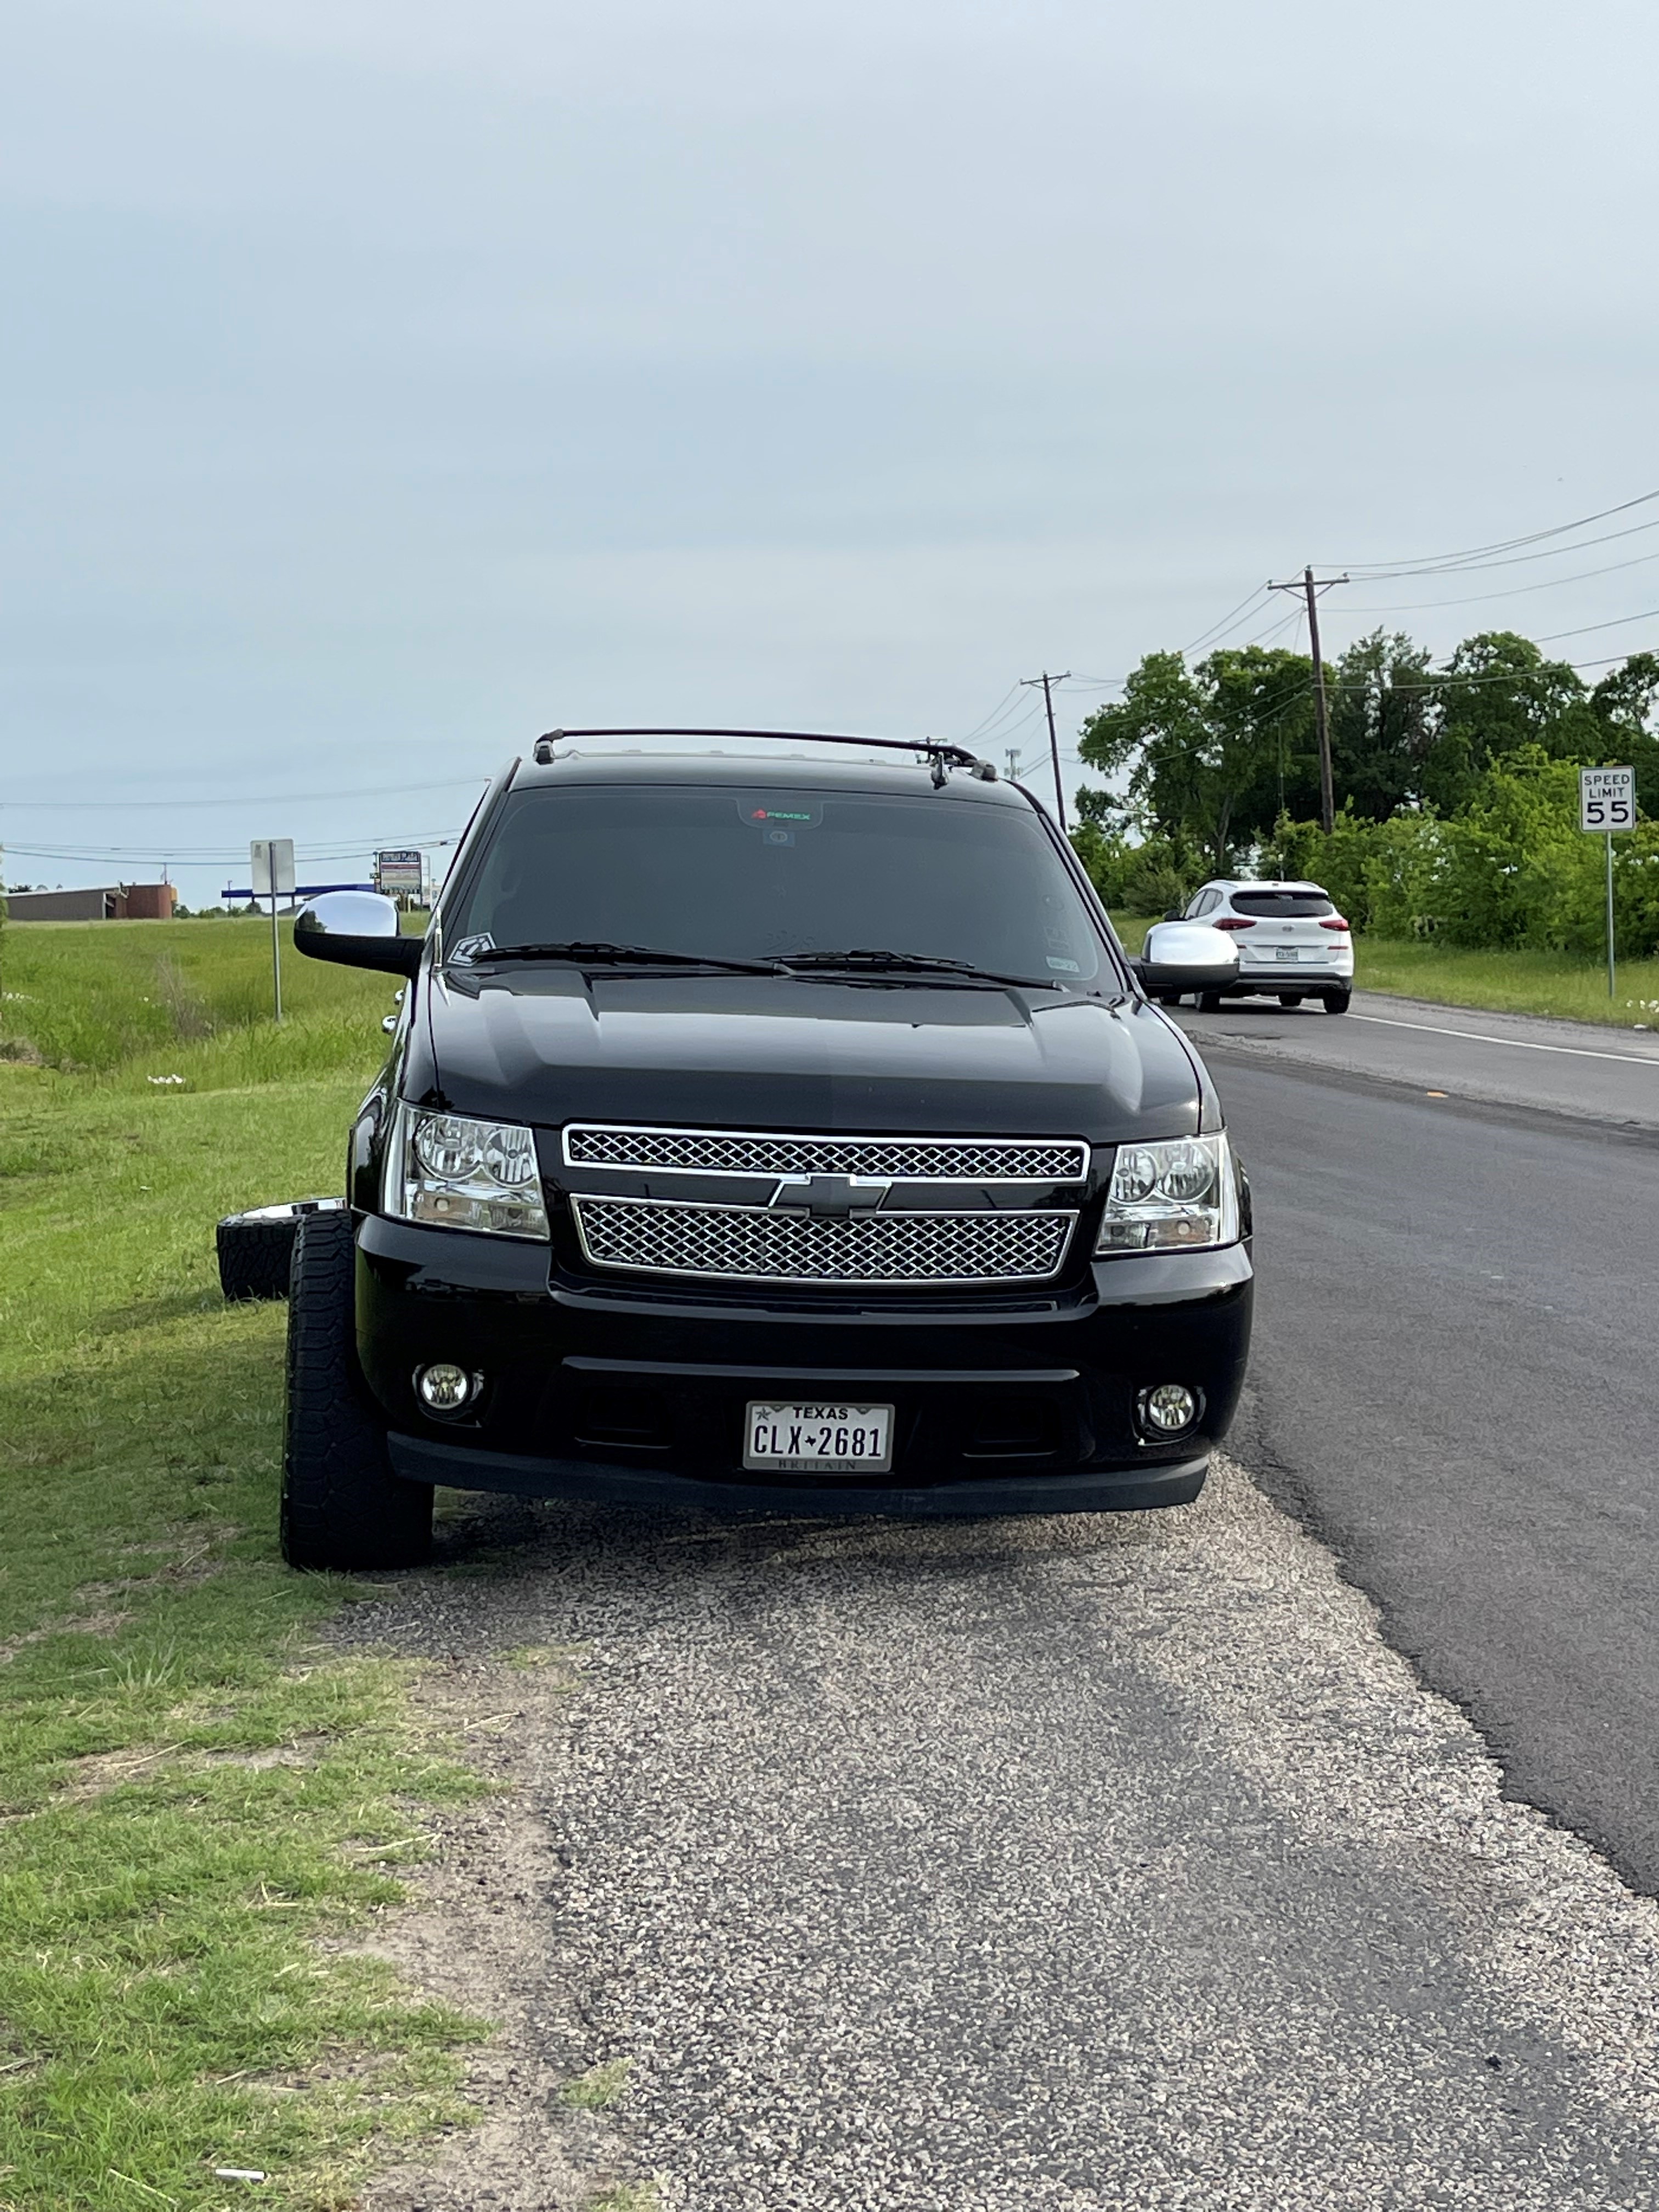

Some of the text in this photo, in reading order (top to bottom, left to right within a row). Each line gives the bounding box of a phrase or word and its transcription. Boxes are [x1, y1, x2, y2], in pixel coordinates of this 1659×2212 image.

[1584, 774, 1630, 786] SPEED
[1589, 787, 1624, 798] LIMIT
[766, 811, 811, 820] PEMEX
[1587, 800, 1629, 823] 55
[793, 1407, 848, 1420] TEXAS
[778, 1460, 857, 1470] BRITAIN
